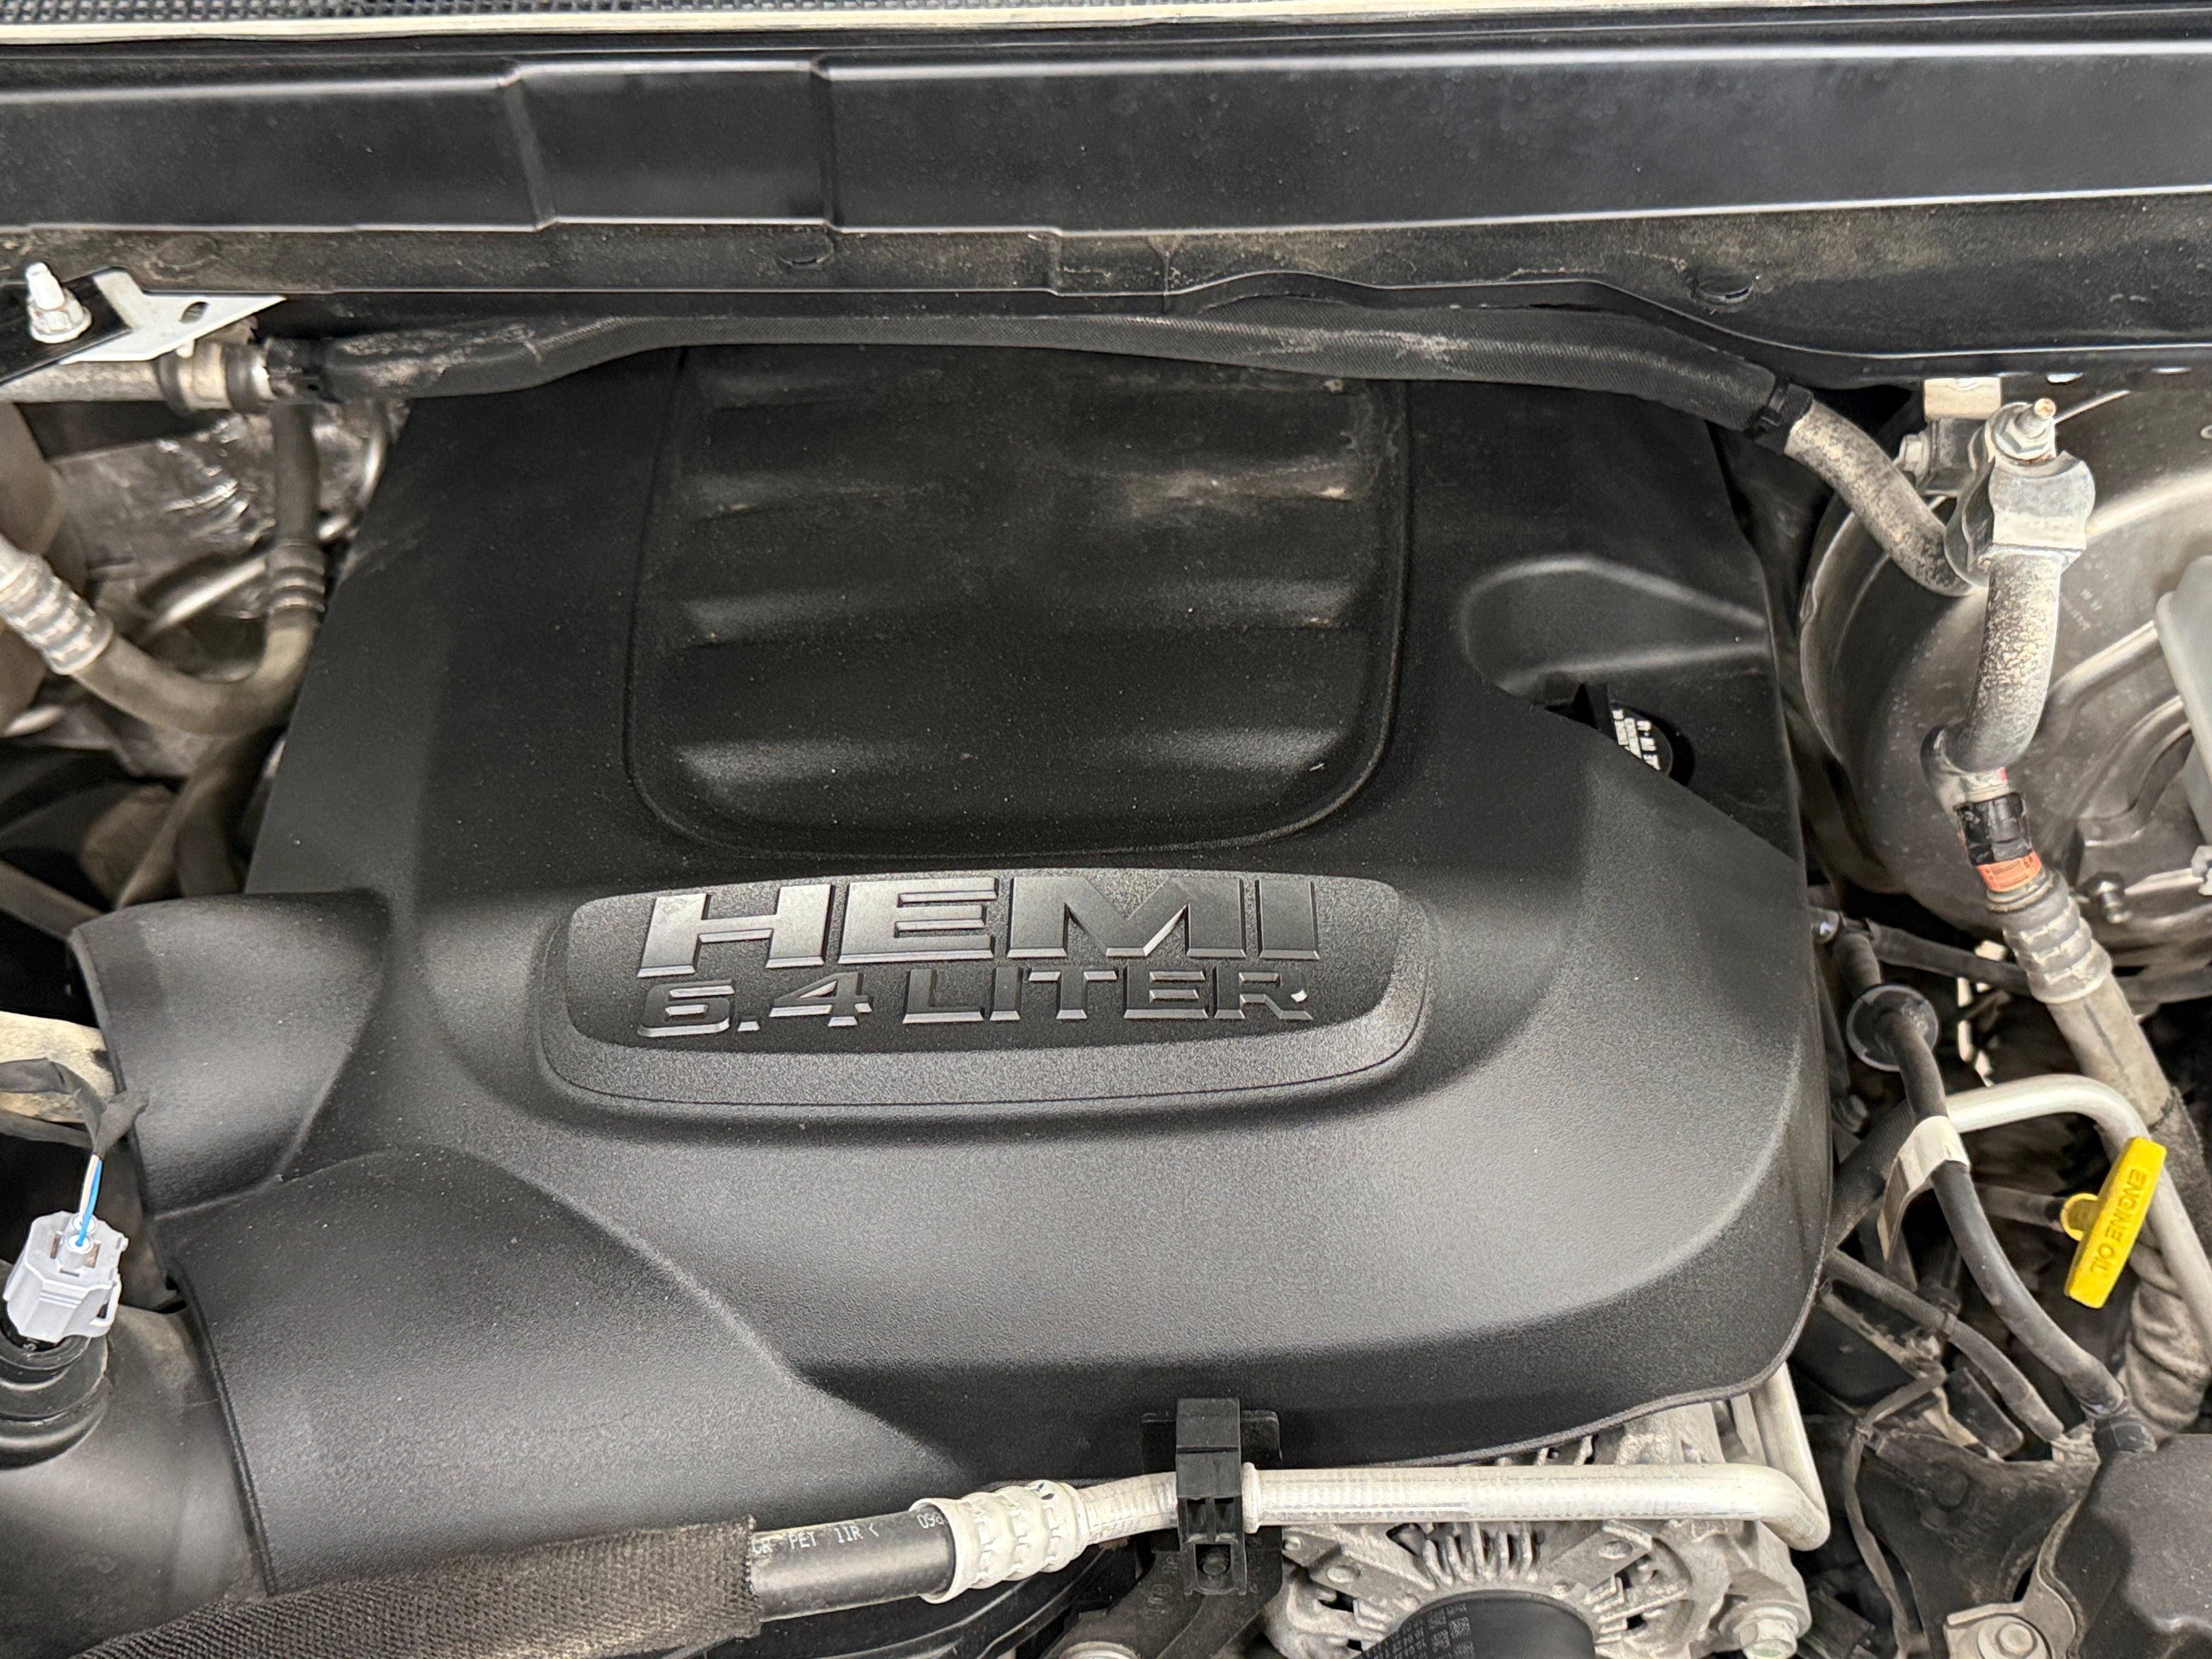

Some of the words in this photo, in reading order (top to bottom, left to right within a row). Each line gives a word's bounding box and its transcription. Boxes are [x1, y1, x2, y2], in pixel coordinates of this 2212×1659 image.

[637, 876, 1320, 978] HEMI
[636, 970, 873, 1039] 6.4
[901, 966, 1314, 1025] LITER
[2105, 1169, 2148, 1242] ENGINE
[2090, 1242, 2115, 1273] OIL
[787, 1531, 817, 1550] PET
